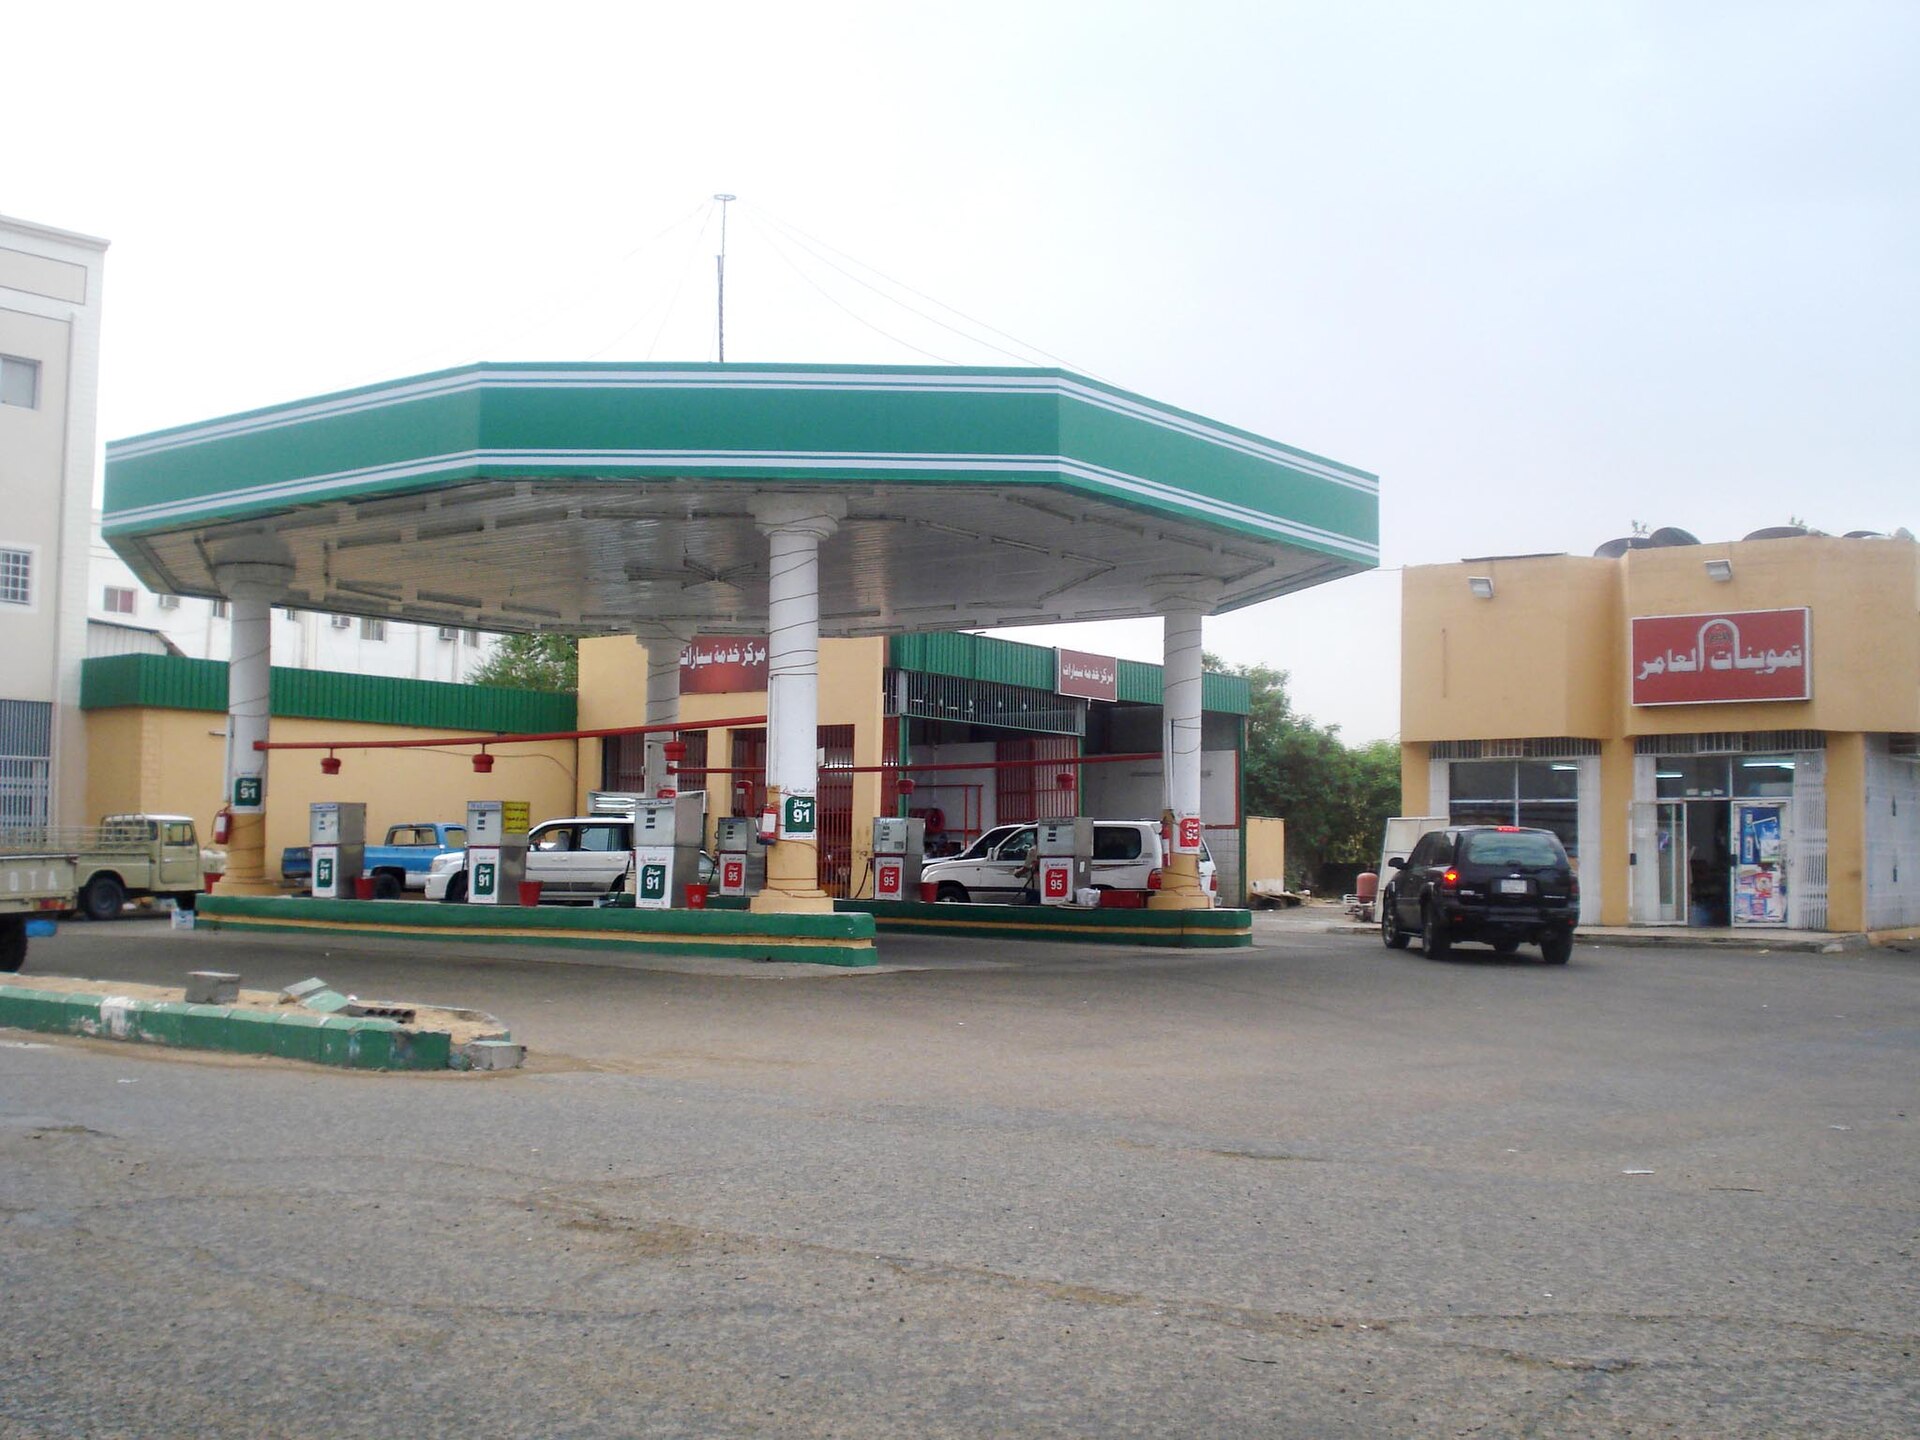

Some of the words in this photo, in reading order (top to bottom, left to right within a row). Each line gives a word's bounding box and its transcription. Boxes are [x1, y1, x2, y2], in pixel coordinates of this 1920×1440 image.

[680, 645, 713, 669] سيارات
[714, 643, 740, 664] خدمة
[741, 642, 766, 667] مركز
[1636, 630, 1705, 680] العامر
[1711, 630, 1802, 673] تموينات
[1062, 663, 1083, 680] سيارات
[1083, 664, 1099, 680] خدمة
[1099, 668, 1114, 685] مركز
[240, 787, 256, 799] 91
[793, 808, 810, 823] 91
[320, 868, 329, 880] 91
[478, 875, 490, 887] 91
[728, 871, 738, 881] 95
[883, 876, 895, 887] 95
[646, 876, 659, 890] 91
[1050, 879, 1063, 890] 95
